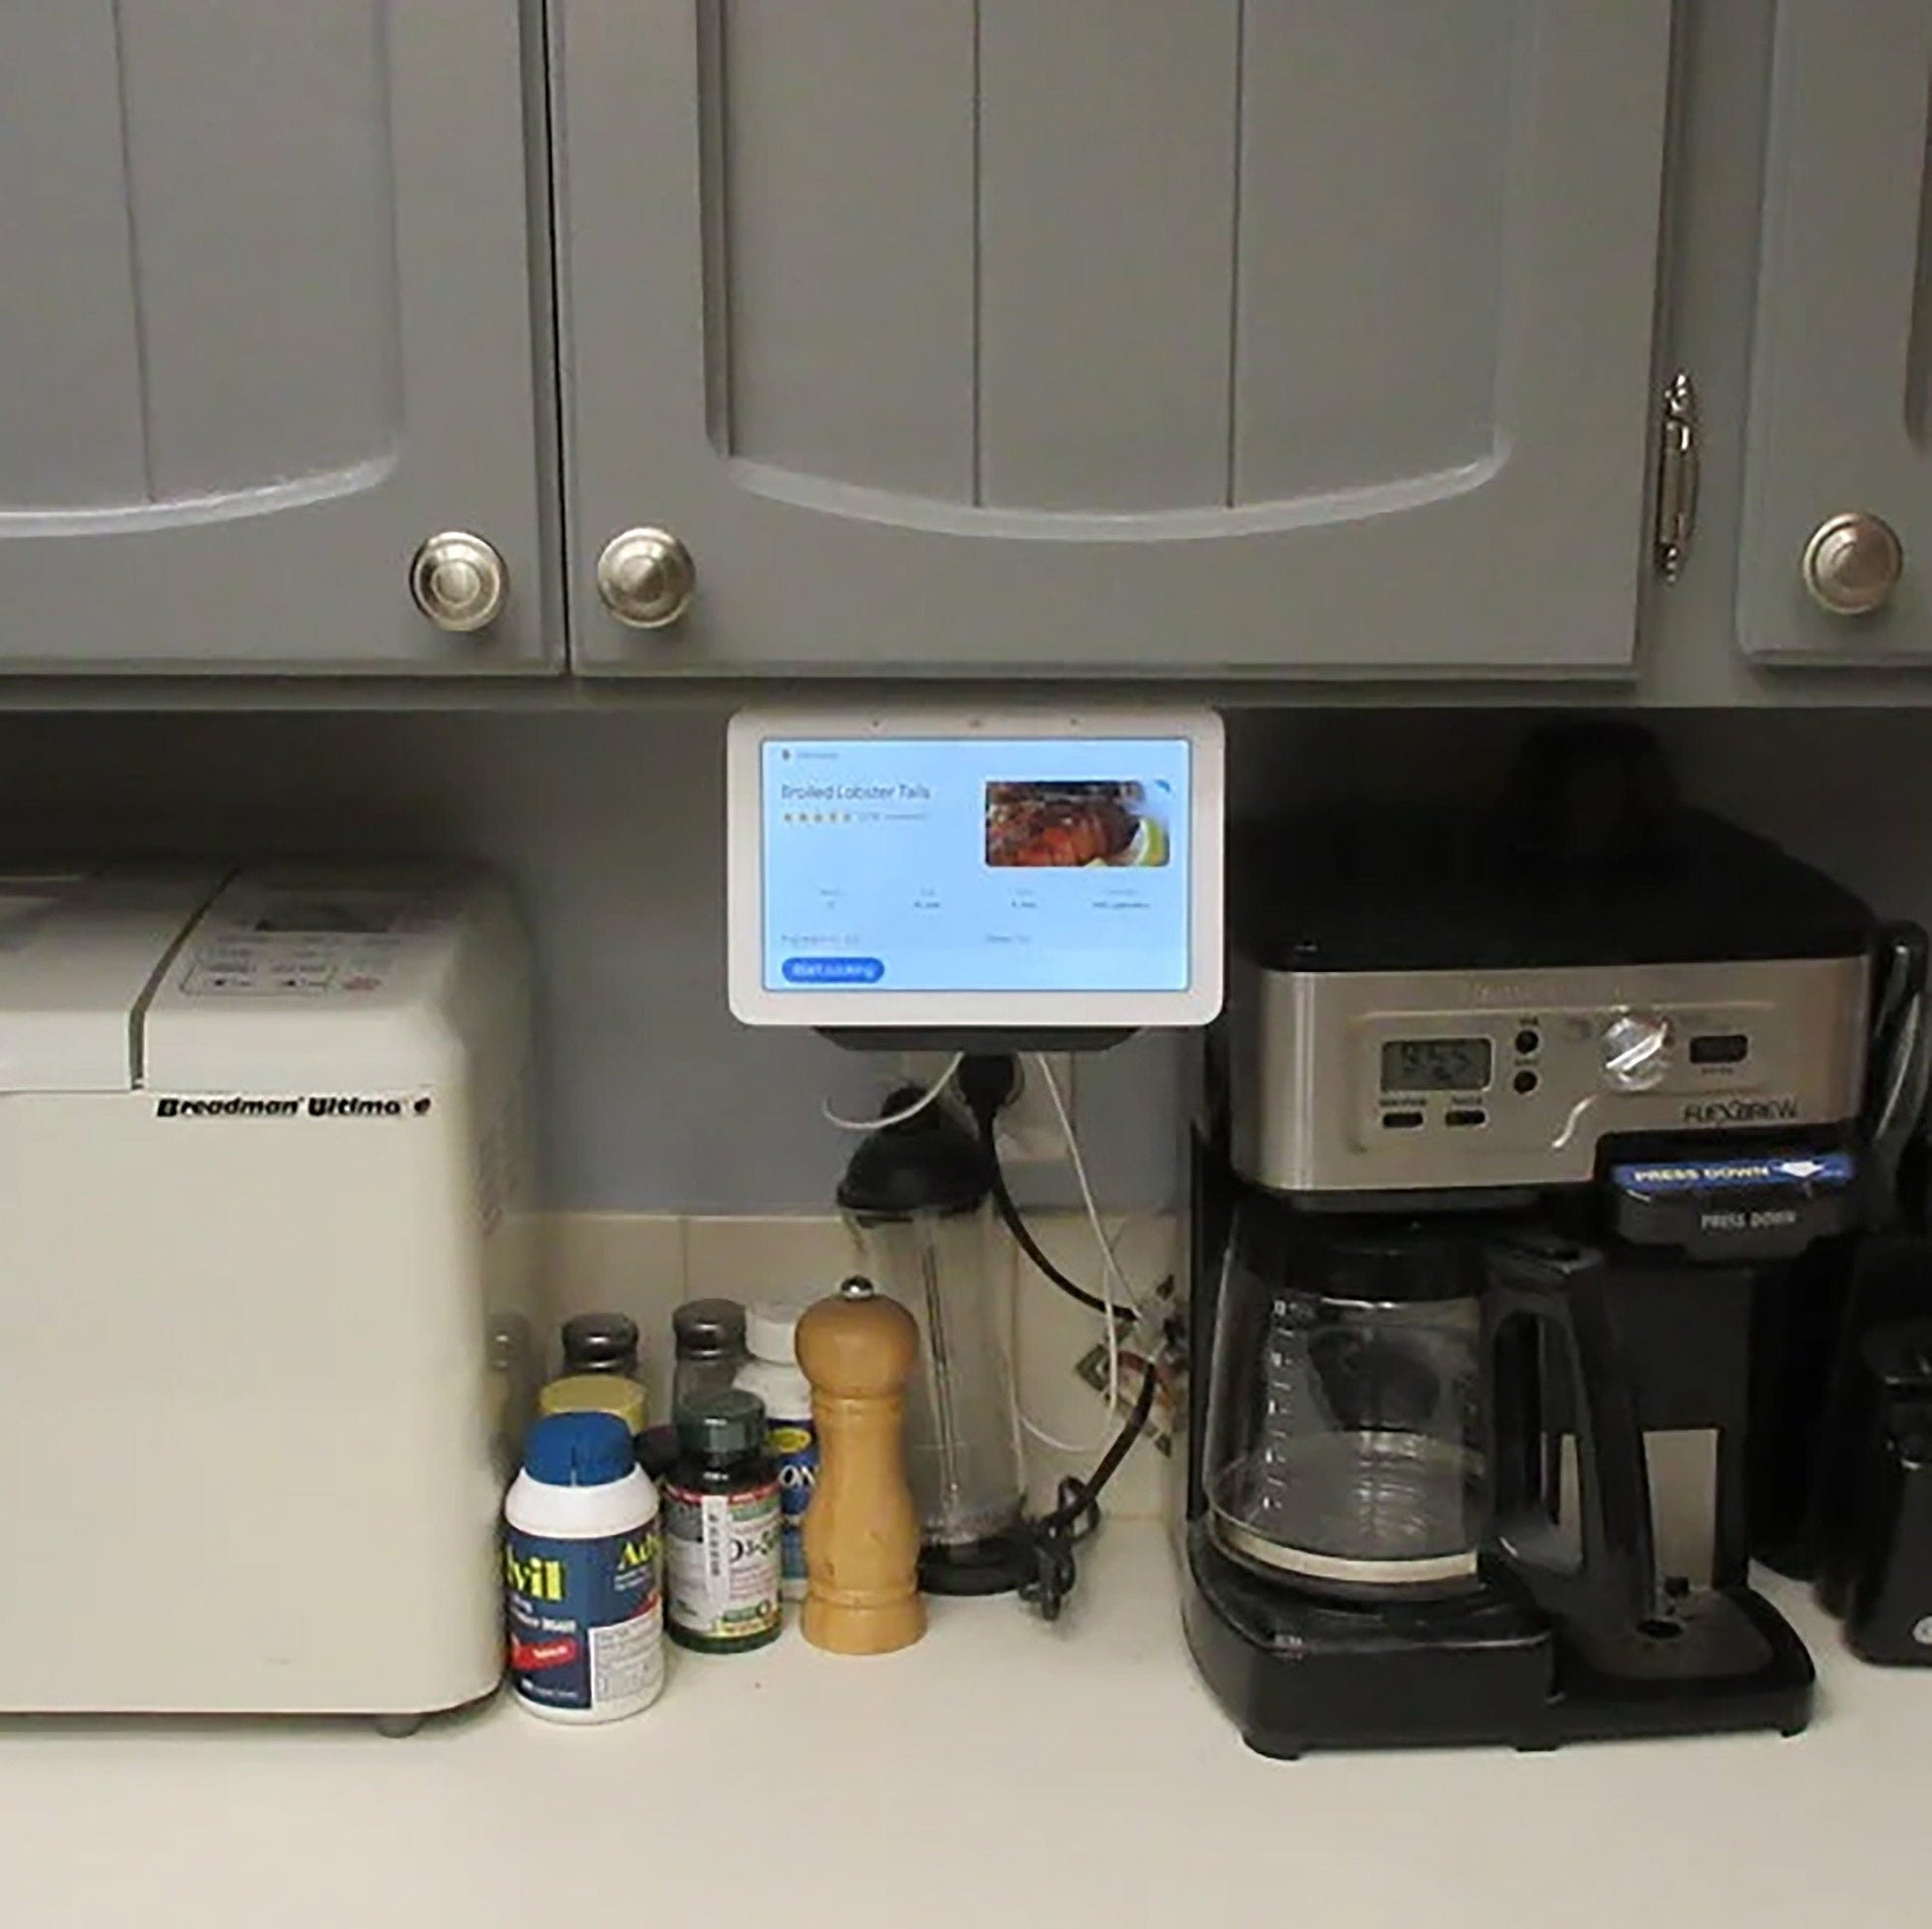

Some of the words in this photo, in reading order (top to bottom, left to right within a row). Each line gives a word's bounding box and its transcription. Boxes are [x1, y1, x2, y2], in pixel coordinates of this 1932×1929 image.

[780, 783, 834, 800] Broiled
[836, 783, 895, 800] Lobster
[897, 783, 931, 800] Tails
[156, 1096, 299, 1118] Breadman
[307, 1096, 401, 1118] Ultima
[1684, 1097, 1799, 1125] FLEXBREW
[1633, 1167, 1701, 1183] PRESS
[1703, 1164, 1771, 1181] DOWN
[1700, 1211, 1746, 1232] PRESS
[1750, 1208, 1797, 1228] DOWN
